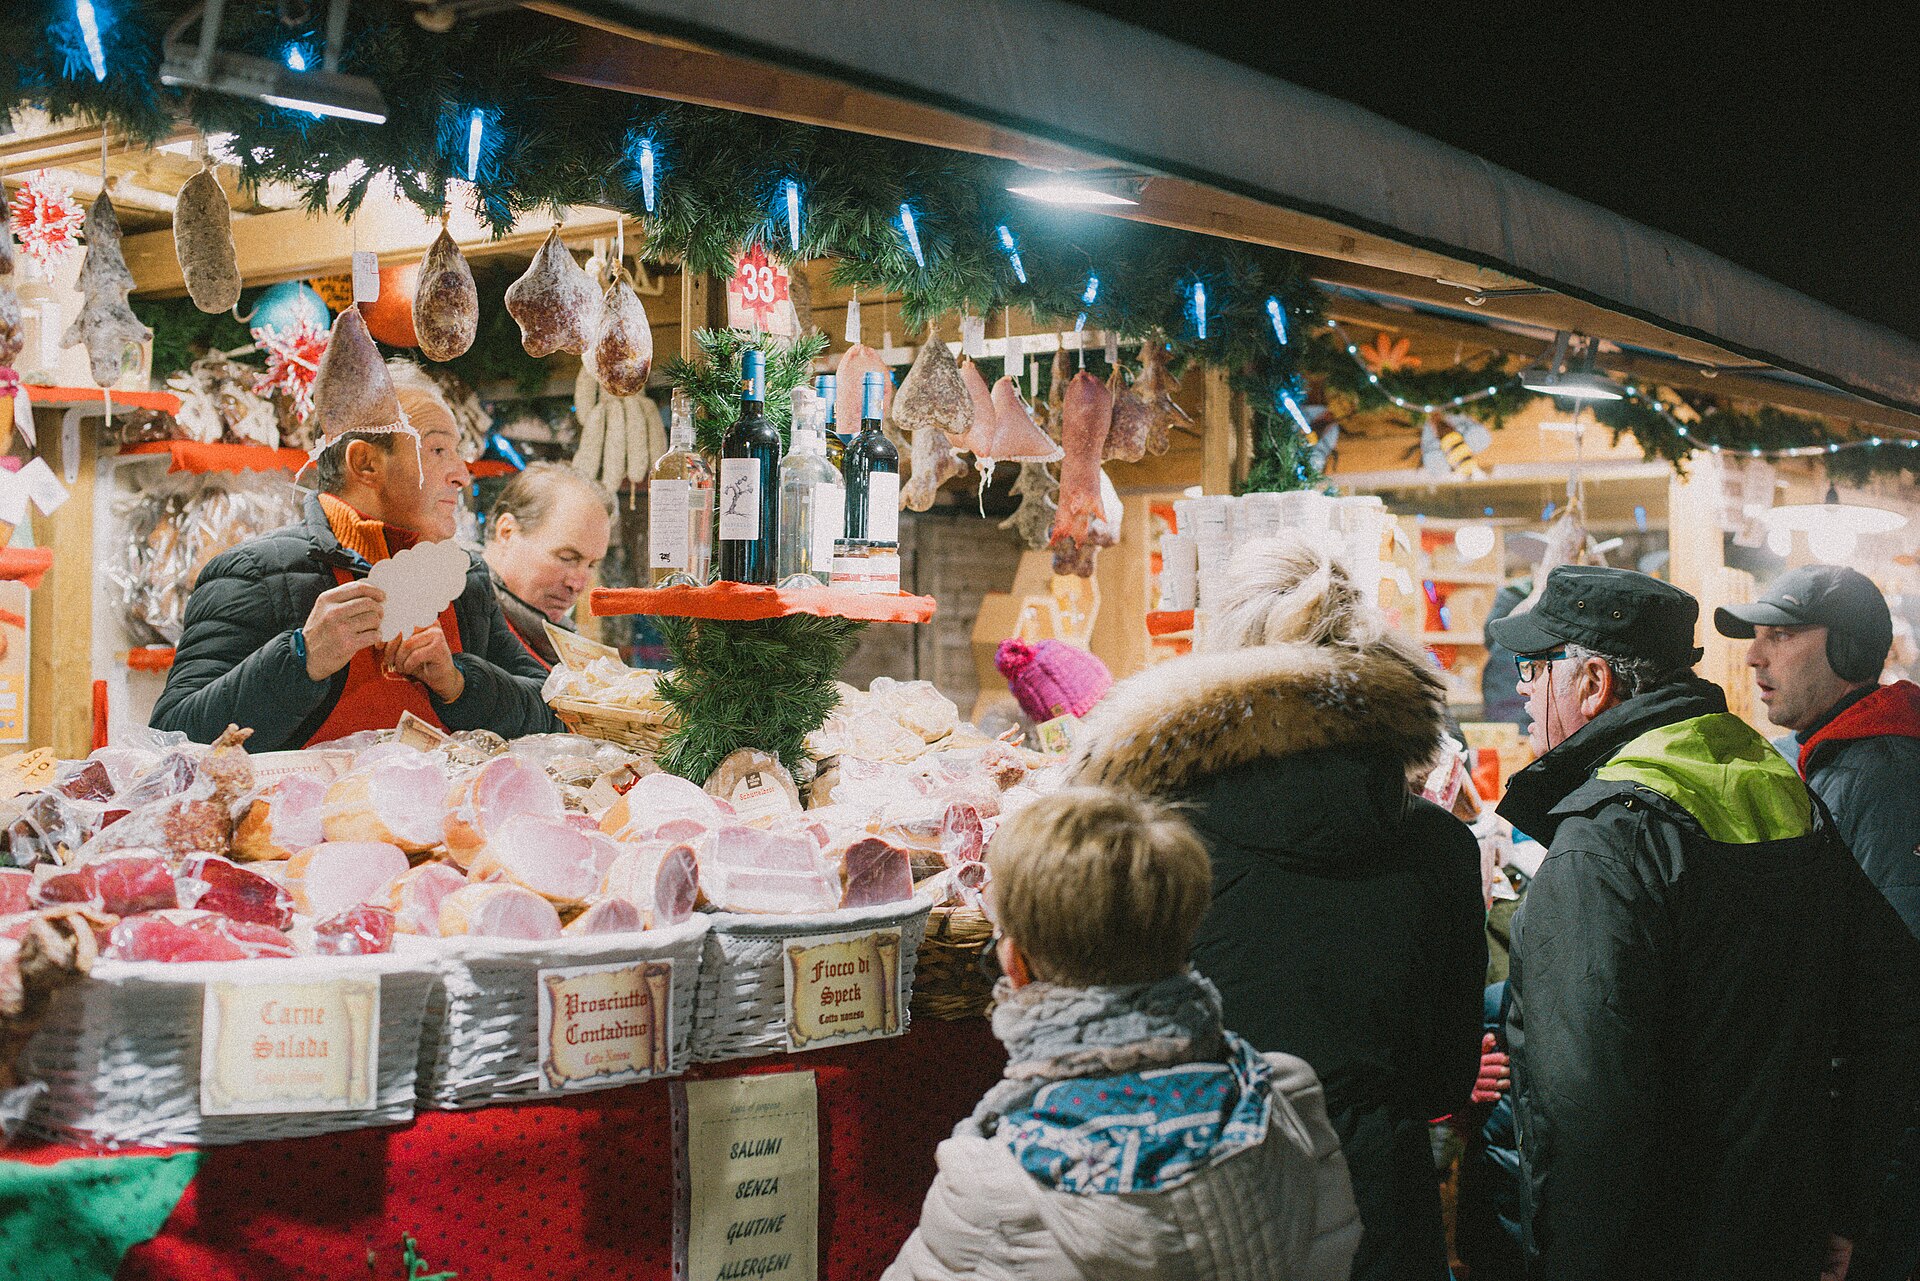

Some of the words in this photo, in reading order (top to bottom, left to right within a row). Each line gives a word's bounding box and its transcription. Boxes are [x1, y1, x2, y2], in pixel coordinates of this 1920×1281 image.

[742, 263, 775, 303] 33
[810, 960, 855, 984] Fiocco
[858, 955, 870, 974] di
[564, 990, 648, 1020] Prosciutto
[820, 983, 862, 1007] Speck
[261, 999, 326, 1025] Carne
[253, 1033, 329, 1059] Salada
[565, 1021, 647, 1046] Contadino
[730, 1138, 783, 1160] SALUMI
[736, 1177, 779, 1199] SENZA
[727, 1214, 786, 1246] GLUTINE
[716, 1253, 792, 1281] ALLERGENI
